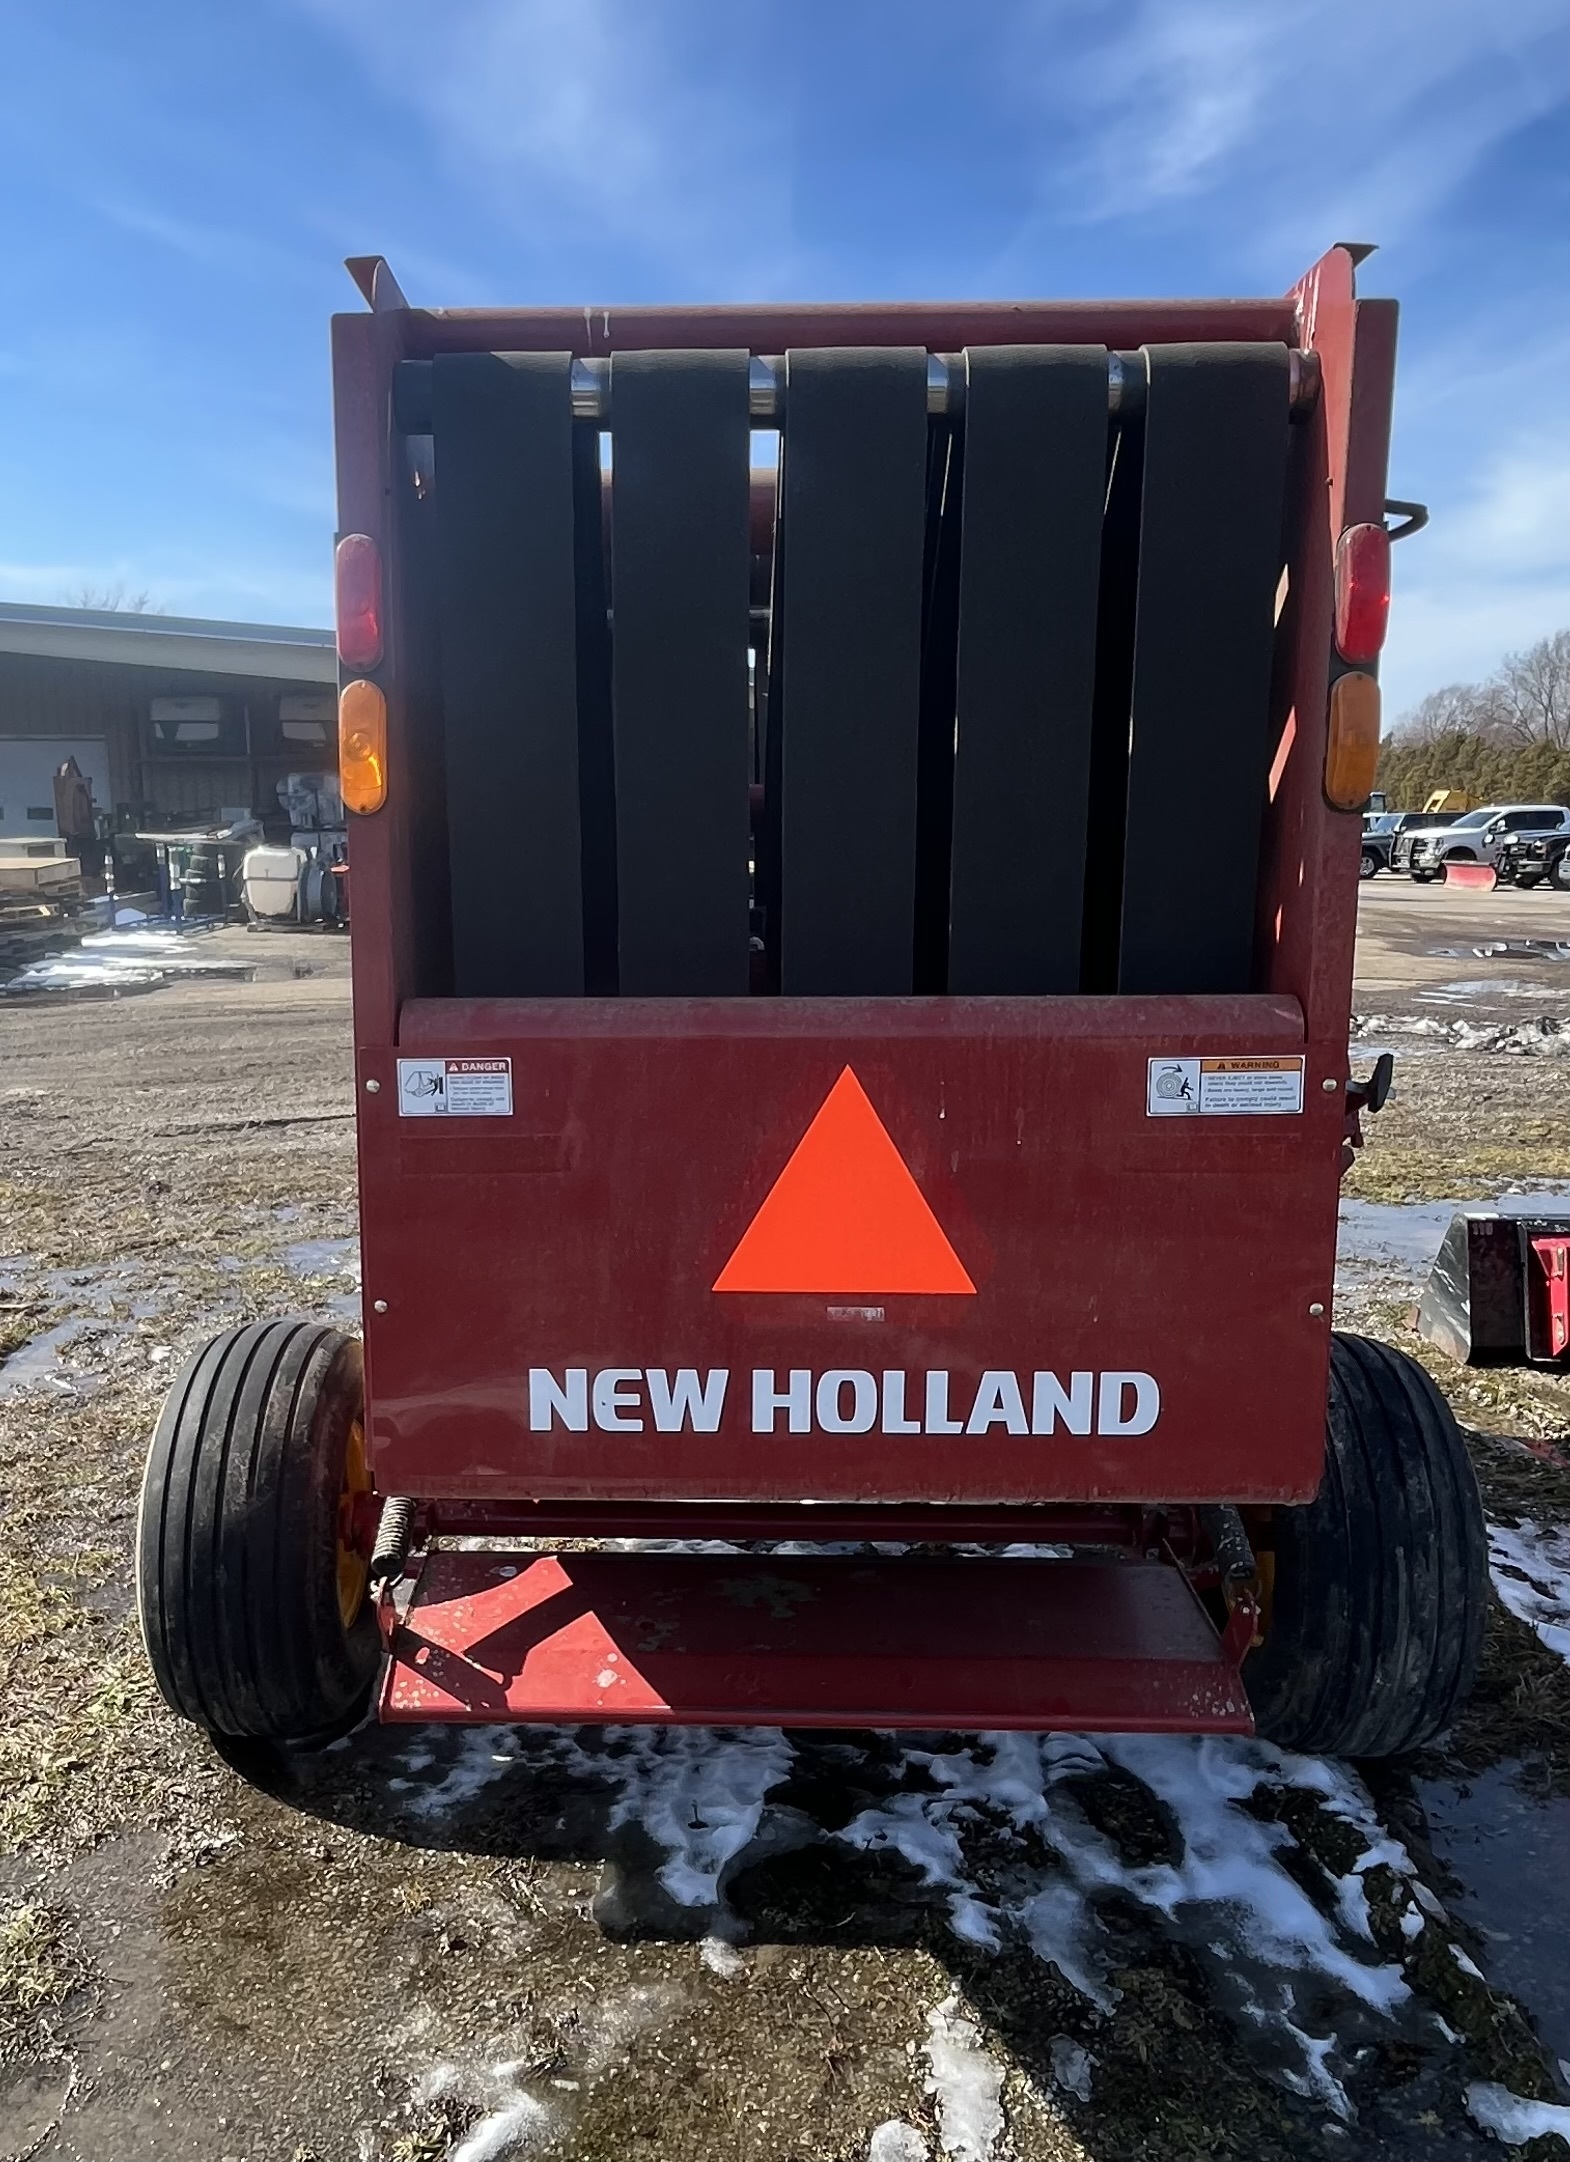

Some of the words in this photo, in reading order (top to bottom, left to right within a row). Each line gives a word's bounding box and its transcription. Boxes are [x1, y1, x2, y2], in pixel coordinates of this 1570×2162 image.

[461, 1062, 506, 1071] DANGER
[1231, 1061, 1280, 1069] WARNING
[528, 1368, 730, 1432] NEW
[751, 1369, 1160, 1436] HOLLAND
